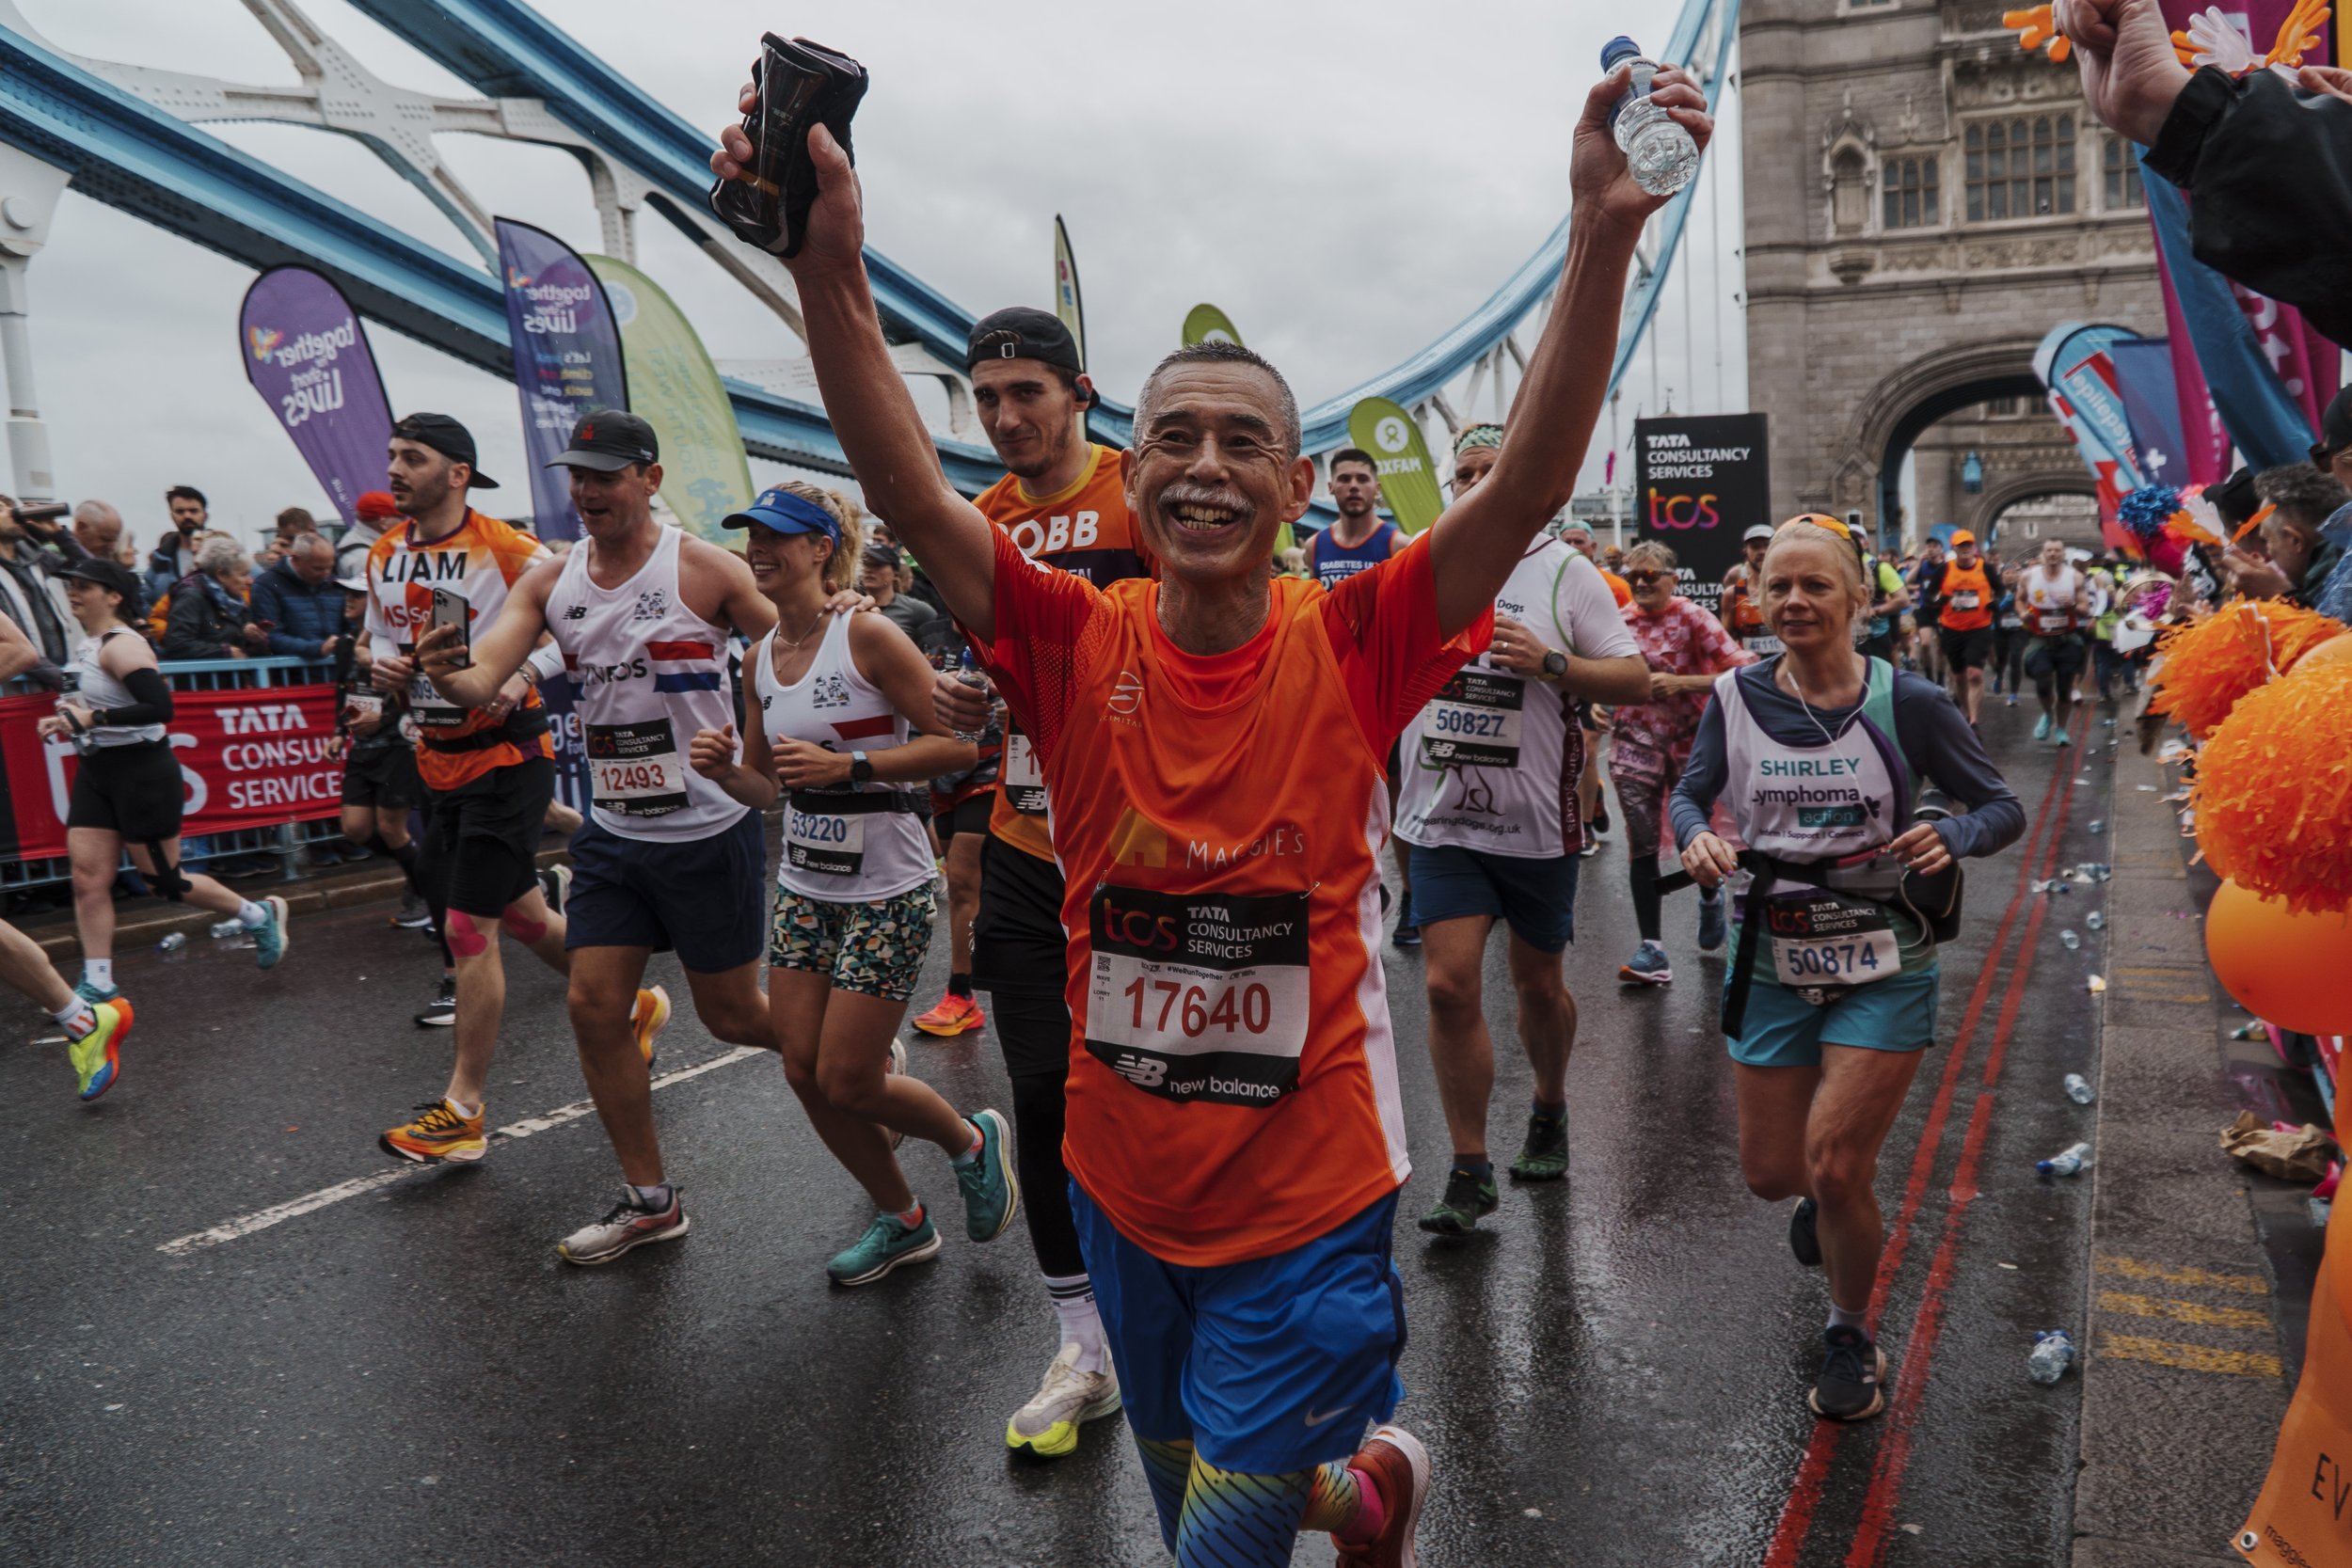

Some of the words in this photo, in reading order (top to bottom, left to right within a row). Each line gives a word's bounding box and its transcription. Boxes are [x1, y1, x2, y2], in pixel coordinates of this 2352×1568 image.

[2071, 372, 2134, 447] epilepsy
[1646, 434, 1692, 449] TATA
[1647, 447, 1752, 464] CONSULTANCY
[1375, 456, 1422, 476] OXFAM
[1648, 465, 1714, 480] SERVICES
[1648, 486, 1721, 530] tcs
[997, 510, 1099, 559] OBB
[382, 552, 469, 583] LIAM
[1320, 560, 1363, 572] DIABETES
[1676, 568, 1695, 581] TA
[1497, 599, 1525, 613] Dogs
[1467, 677, 1488, 687] TATA
[1465, 692, 1497, 703] SERVICES
[1466, 685, 1517, 699] CONSULTANCY
[215, 705, 309, 735] TATA
[1436, 708, 1505, 737] 50827
[615, 733, 666, 746] CONSULTANCY
[617, 744, 649, 754] SERVICES
[1454, 752, 1473, 761] new
[1473, 752, 1509, 765] balance
[1760, 757, 1861, 777] SHIRLEY
[601, 764, 665, 791] 12493
[228, 770, 345, 809] SERVICE
[1752, 784, 1860, 807] ymphoma
[644, 804, 680, 816] balance
[1804, 810, 1853, 824] action
[791, 812, 847, 843] 53220
[1788, 829, 1820, 840] Support
[1828, 829, 1866, 838] Connect
[806, 860, 819, 869] new
[819, 858, 852, 873] balance
[1187, 906, 1231, 923] TATA
[1809, 901, 1840, 912] TATA
[1812, 908, 1877, 923] CONSULTANCY
[1103, 897, 1179, 952] tcs
[1187, 922, 1294, 942] CONSULTANCY
[1814, 919, 1858, 932] SERVICES
[1187, 940, 1253, 960] SERVICES
[1788, 942, 1879, 976] 50874
[1168, 966, 1223, 982] #WeRunTogether
[1124, 976, 1271, 1037] 17640
[1169, 1078, 1205, 1095] new
[1210, 1076, 1280, 1099] balance
[2265, 1525, 2312, 1568] maggie
